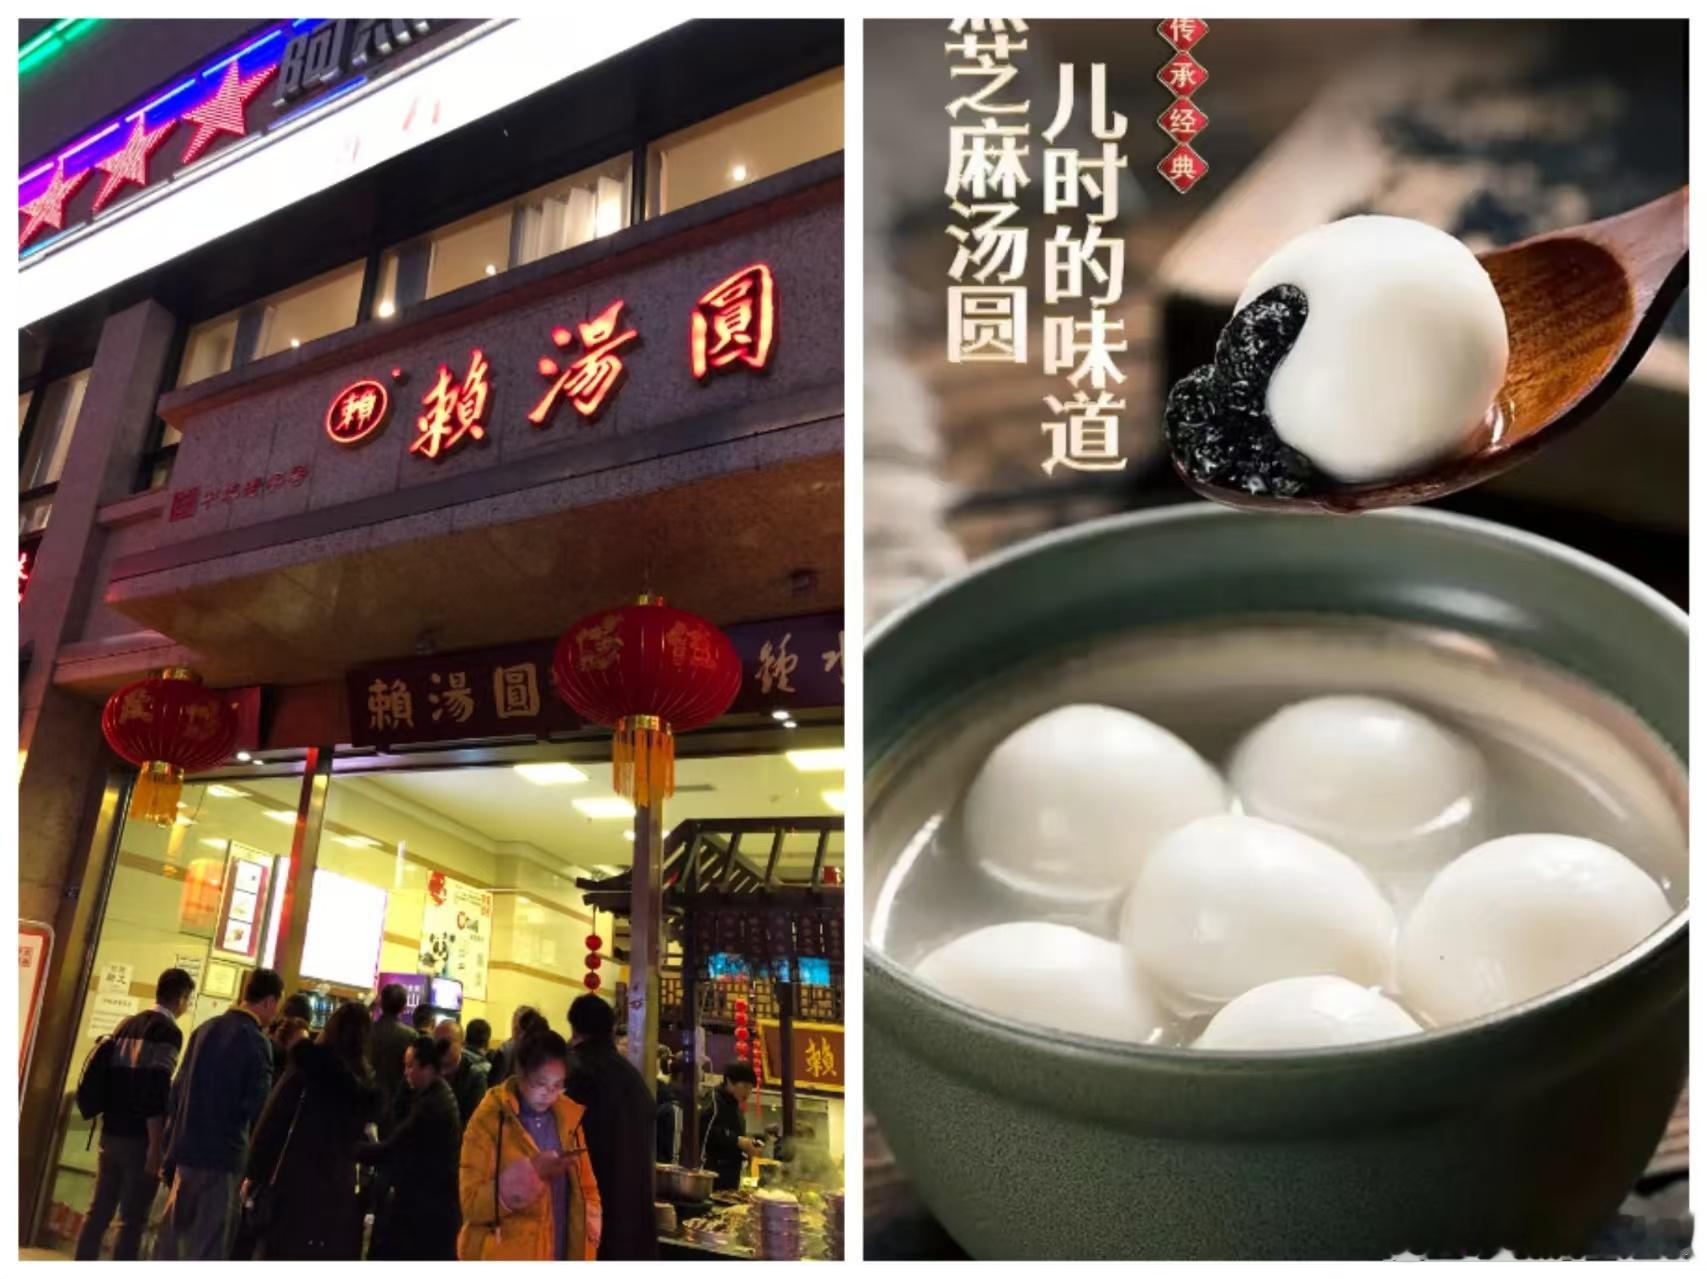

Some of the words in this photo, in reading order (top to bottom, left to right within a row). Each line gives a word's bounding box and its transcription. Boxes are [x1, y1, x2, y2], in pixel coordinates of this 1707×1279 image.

[410, 263, 776, 458] 賴湯圓
[367, 662, 541, 732] 賴湯圓
[805, 1036, 838, 1078] 賴
